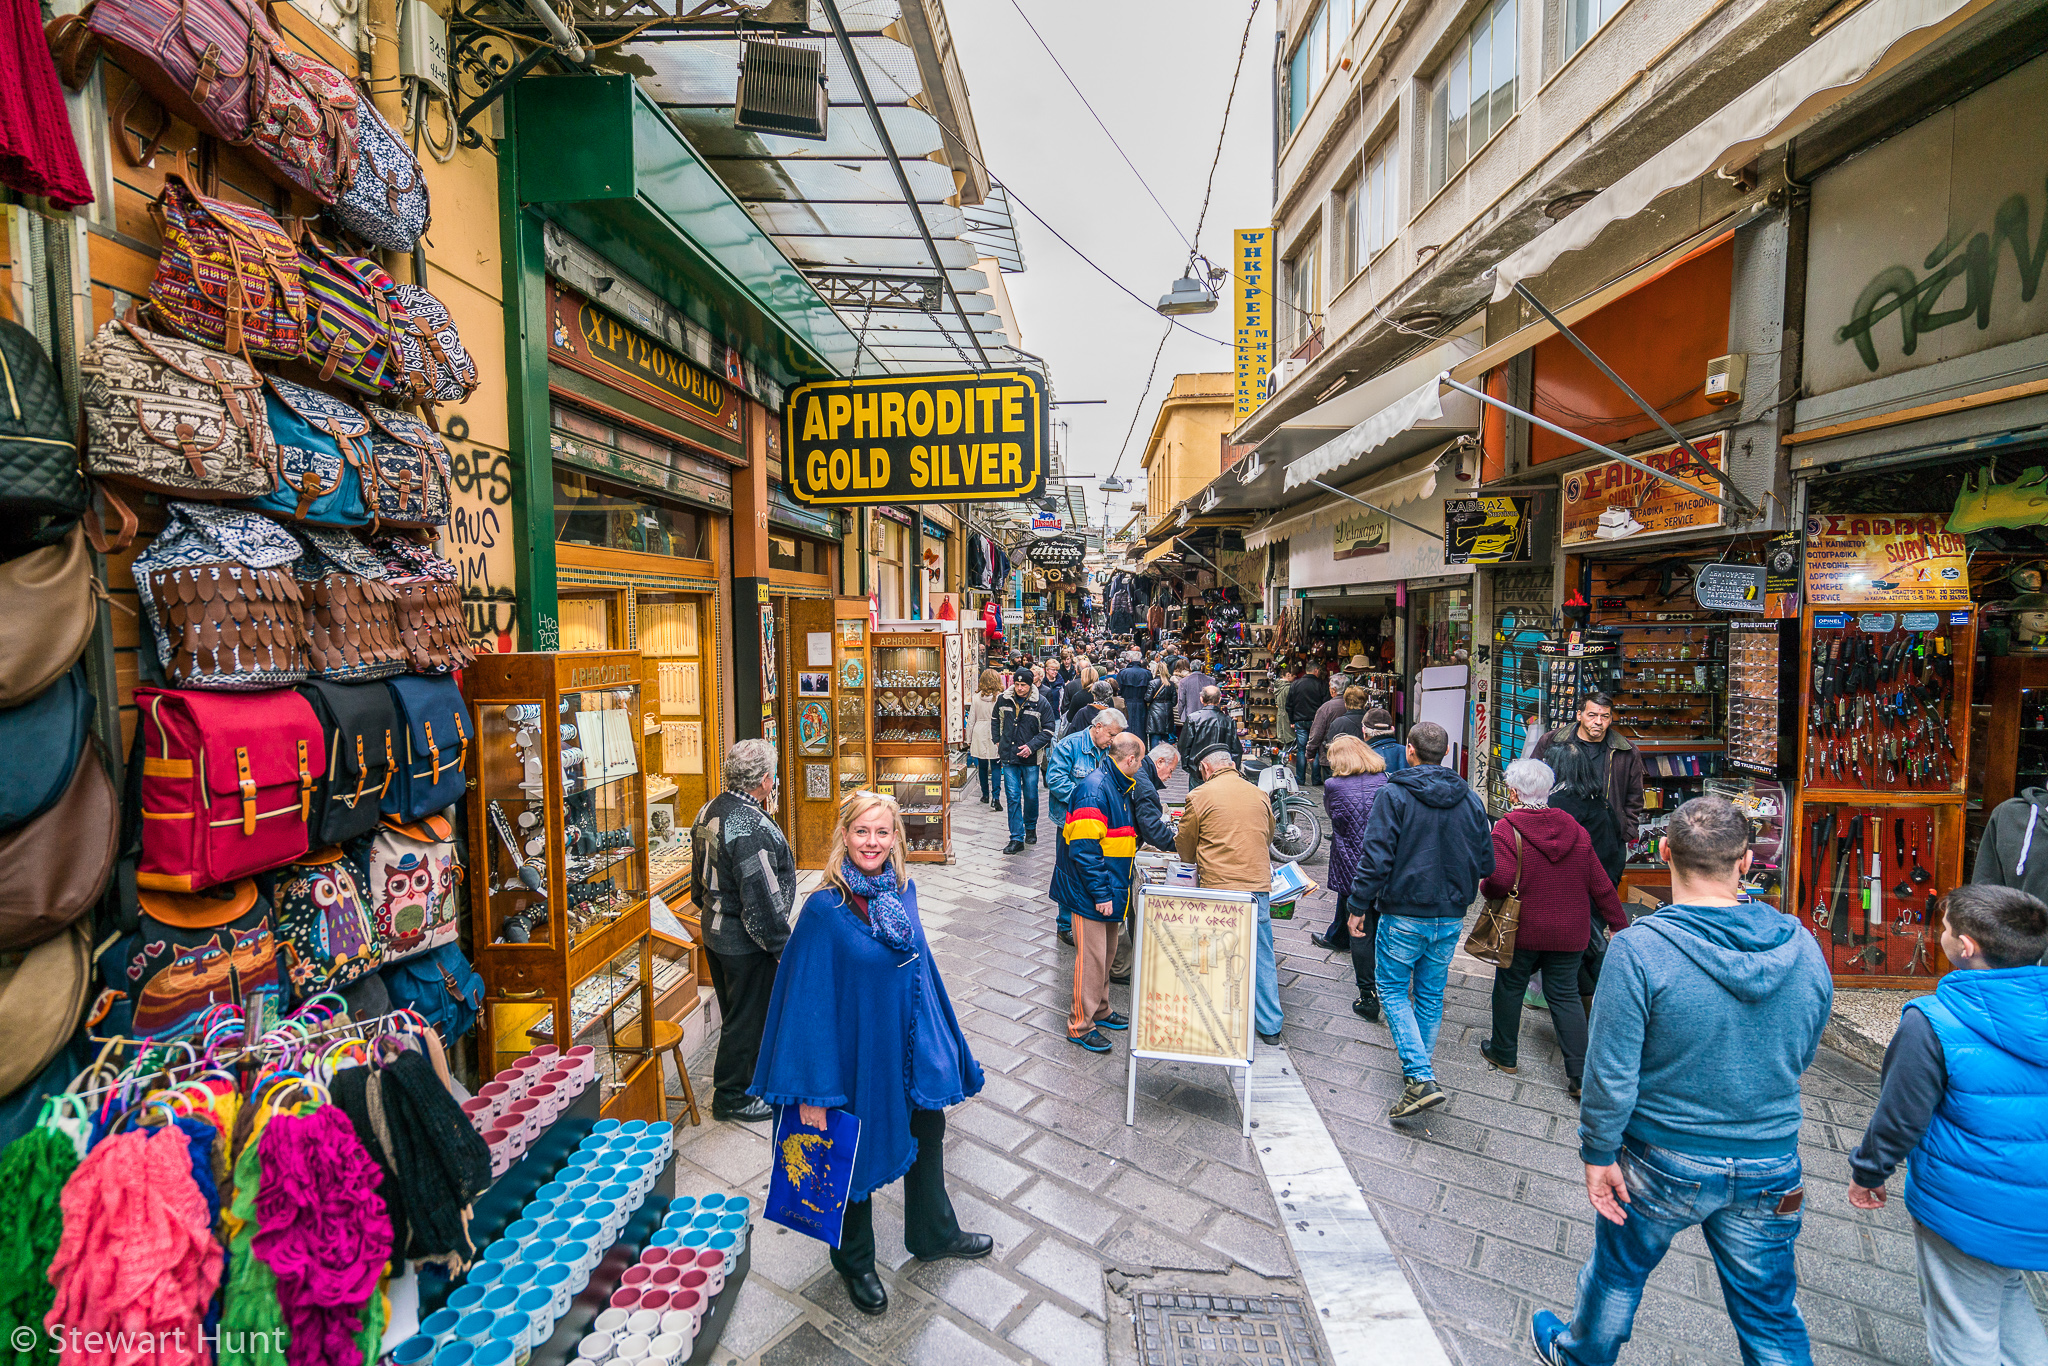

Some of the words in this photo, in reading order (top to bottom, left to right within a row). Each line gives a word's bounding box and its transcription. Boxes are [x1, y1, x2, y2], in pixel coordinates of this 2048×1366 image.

[1241, 233, 1265, 326] ΨΗΚΤΡΕΣ
[588, 307, 720, 407] ΧΡΥΣΟΧΟΕΙΟ
[1238, 329, 1250, 413] ΗΛΕΚΤΡΙΚΩΝ
[1255, 330, 1268, 409] ΜΗΧΑΝΩ
[802, 385, 1025, 441] APHRODITE
[806, 447, 890, 491] GOLD
[910, 442, 1022, 488] SILVER
[1583, 438, 1719, 500] ΣΑΒΒΑΣ
[1446, 498, 1506, 513] ΣΑΒΒΑΣ
[1487, 509, 1519, 518] Survivor
[756, 511, 767, 530] 13
[1032, 518, 1062, 531] LONSDALE
[1579, 517, 1599, 528] ΚΑΠΝΙΣ
[1664, 514, 1694, 527] SERVICE
[1825, 540, 1866, 548] ΚΑΠΝΙΣΤΟΥ
[1806, 551, 1858, 559] ΦΩΤΟΓΡΑΦΙΚΑ
[1810, 583, 1844, 591] ΚΑΜΕΡΕΣ
[1811, 594, 1841, 602] SERVICE
[880, 636, 931, 646] APHRODITE
[1583, 645, 1604, 654] zippo
[571, 664, 632, 688] APHRODITE
[1147, 897, 1175, 910] HAVE
[1213, 903, 1245, 916] NAME
[1153, 912, 1184, 923] MADE
[1189, 915, 1200, 925] IN
[1205, 916, 1238, 928] GREEK
[779, 1205, 823, 1230] Greece
